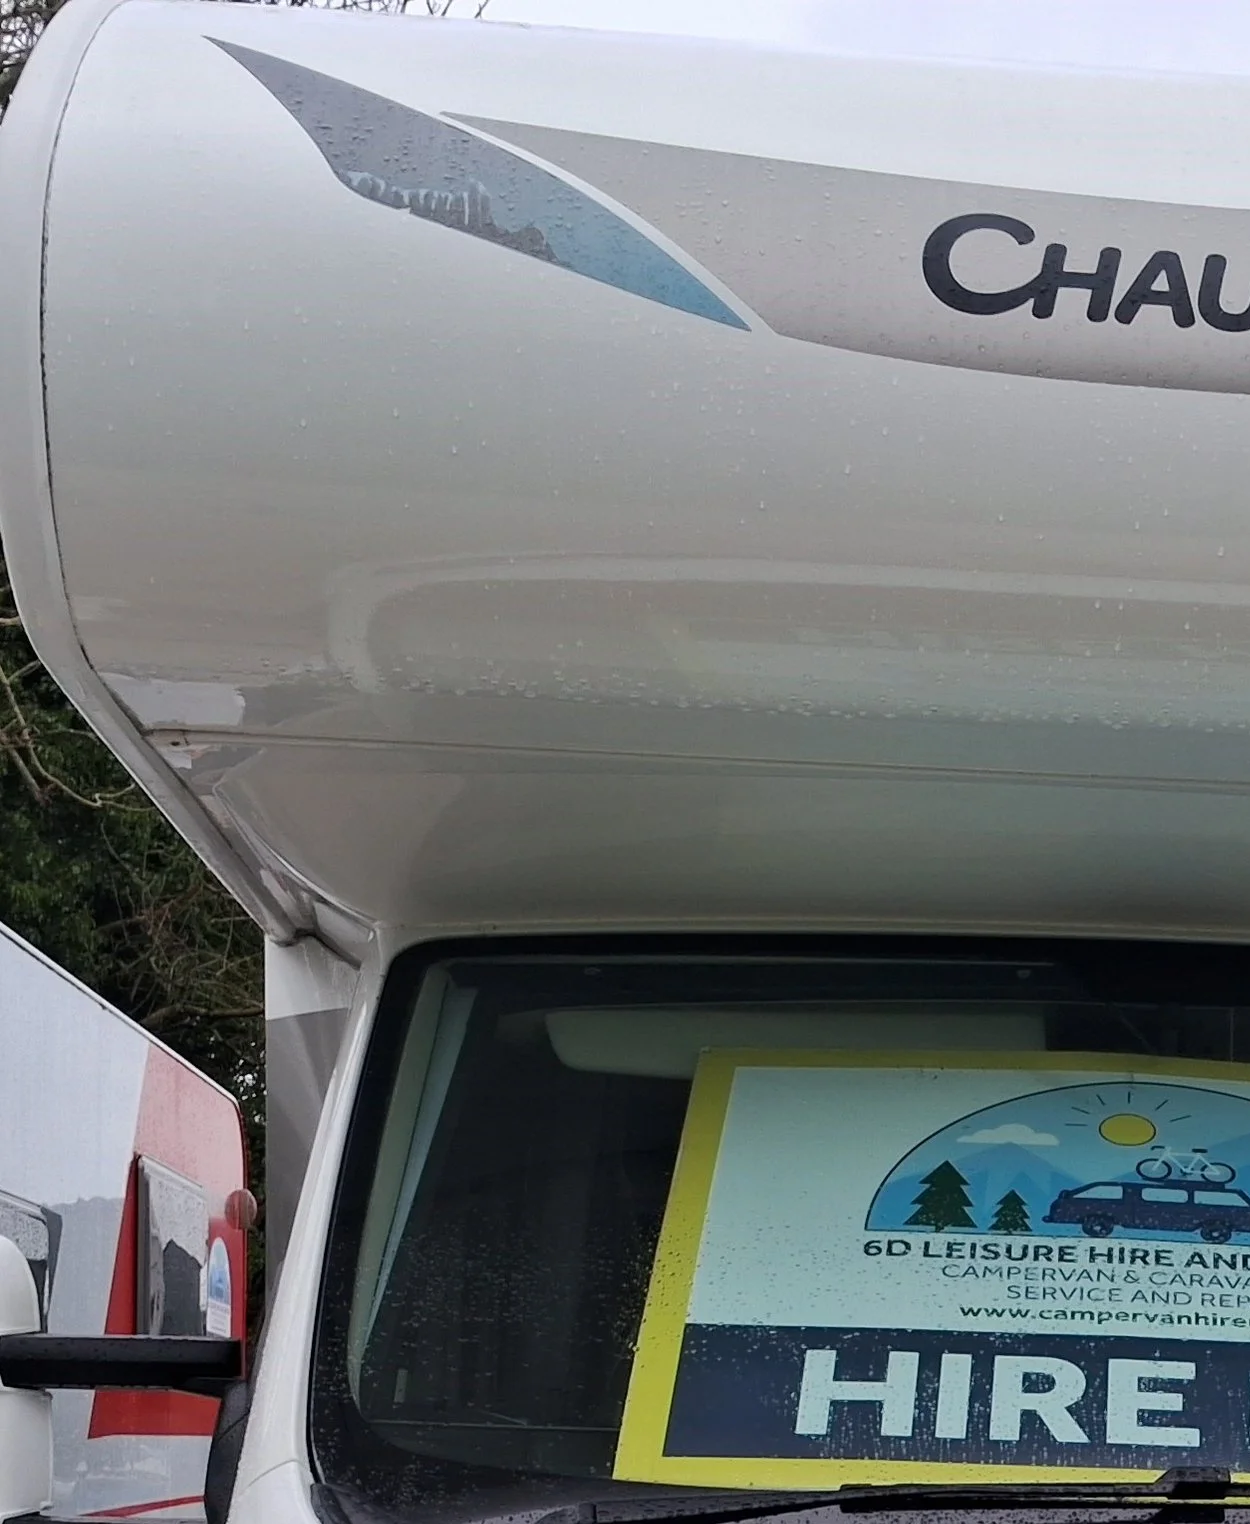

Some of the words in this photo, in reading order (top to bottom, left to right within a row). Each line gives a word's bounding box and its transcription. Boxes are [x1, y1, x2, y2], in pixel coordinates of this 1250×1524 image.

[863, 1239, 911, 1256] 6D
[922, 1240, 1077, 1263] LEISURE
[1088, 1246, 1174, 1267] HIRE
[942, 1264, 1114, 1283] CAMPERVAN
[1123, 1269, 1140, 1283] &
[1006, 1285, 1122, 1302] SERVICE
[1131, 1290, 1192, 1305] AND
[795, 1350, 1199, 1448] HIRE
